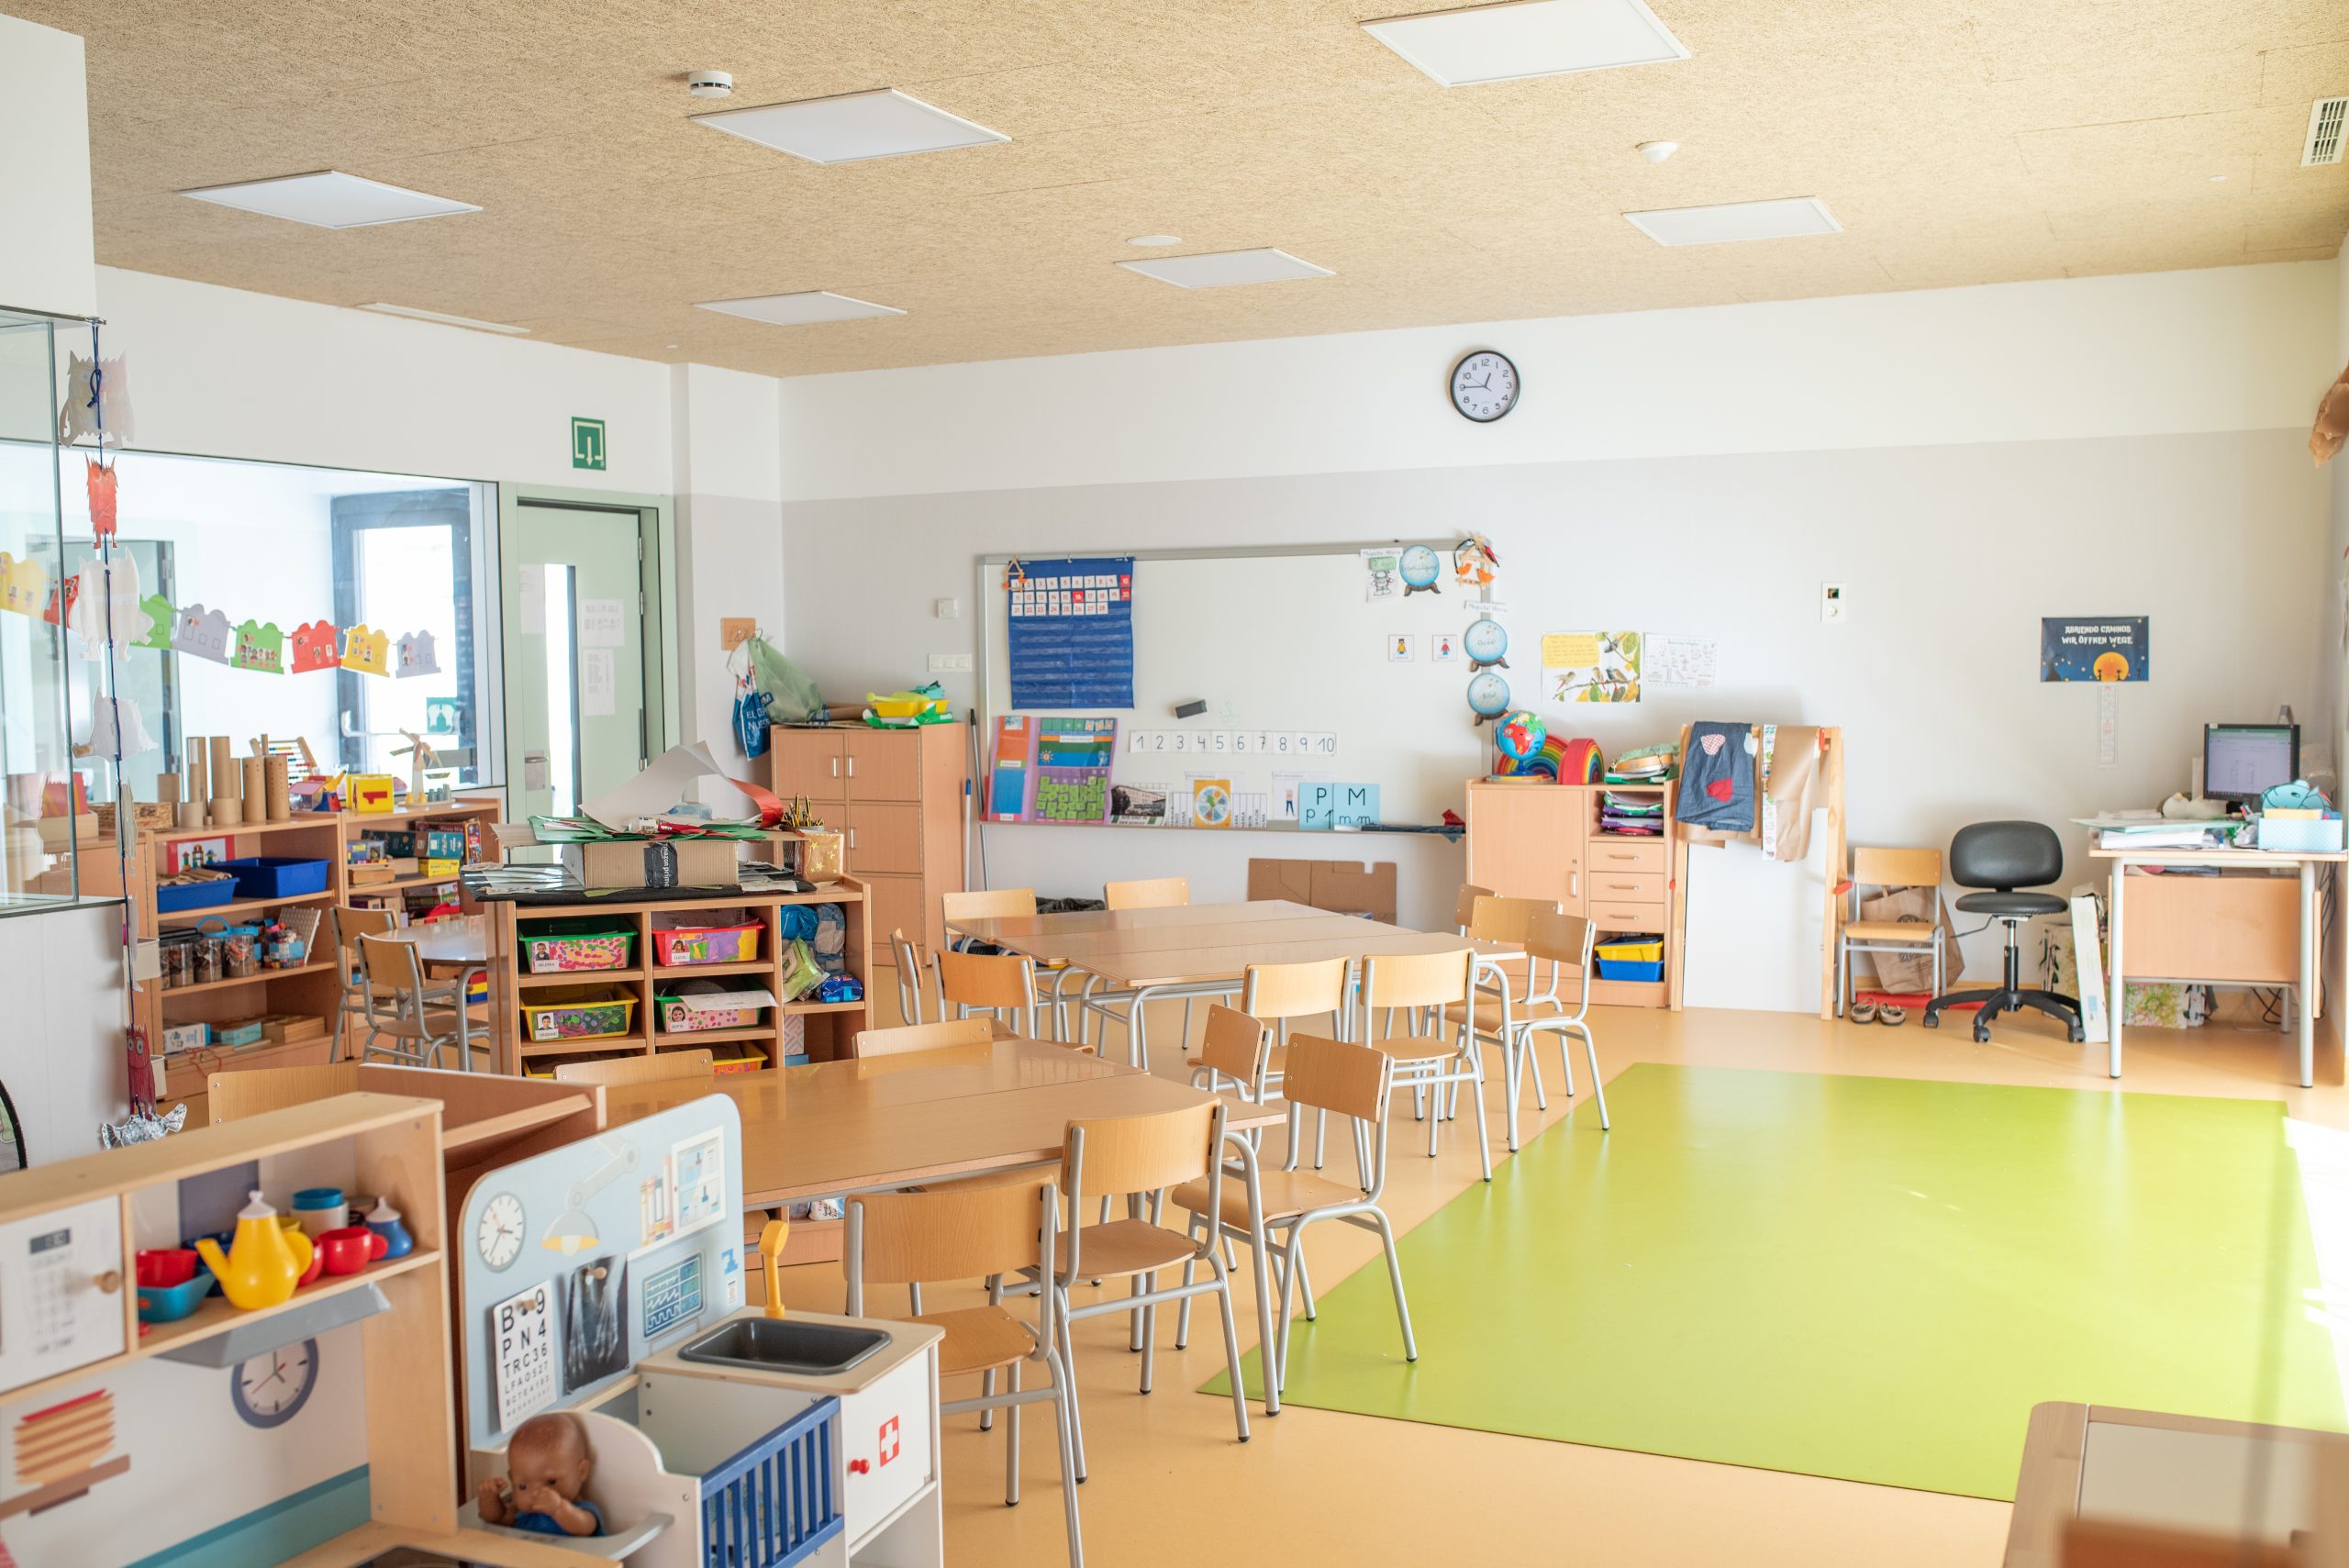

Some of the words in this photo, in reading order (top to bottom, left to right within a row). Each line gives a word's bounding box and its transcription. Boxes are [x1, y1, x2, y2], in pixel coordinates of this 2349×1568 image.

[2078, 635, 2107, 644] ÖFFNEN
[1136, 736, 1143, 749] 1
[1156, 735, 1164, 749] 2
[1177, 736, 1184, 749] 3
[1198, 735, 1205, 749] 4
[1216, 736, 1224, 749] 5
[1237, 736, 1244, 750] 6
[1259, 736, 1266, 750] 7
[1279, 737, 1287, 751] 8
[1300, 737, 1307, 751] 9
[1317, 738, 1334, 752] 10
[1317, 788, 1326, 805] P
[1349, 788, 1365, 805] M
[1307, 809, 1315, 823] p
[1340, 816, 1351, 824] m
[663, 867, 671, 887] prime
[502, 1305, 514, 1334] B
[535, 1289, 545, 1314] 9
[503, 1338, 511, 1360] P
[521, 1327, 530, 1349] N
[538, 1318, 546, 1337] 4
